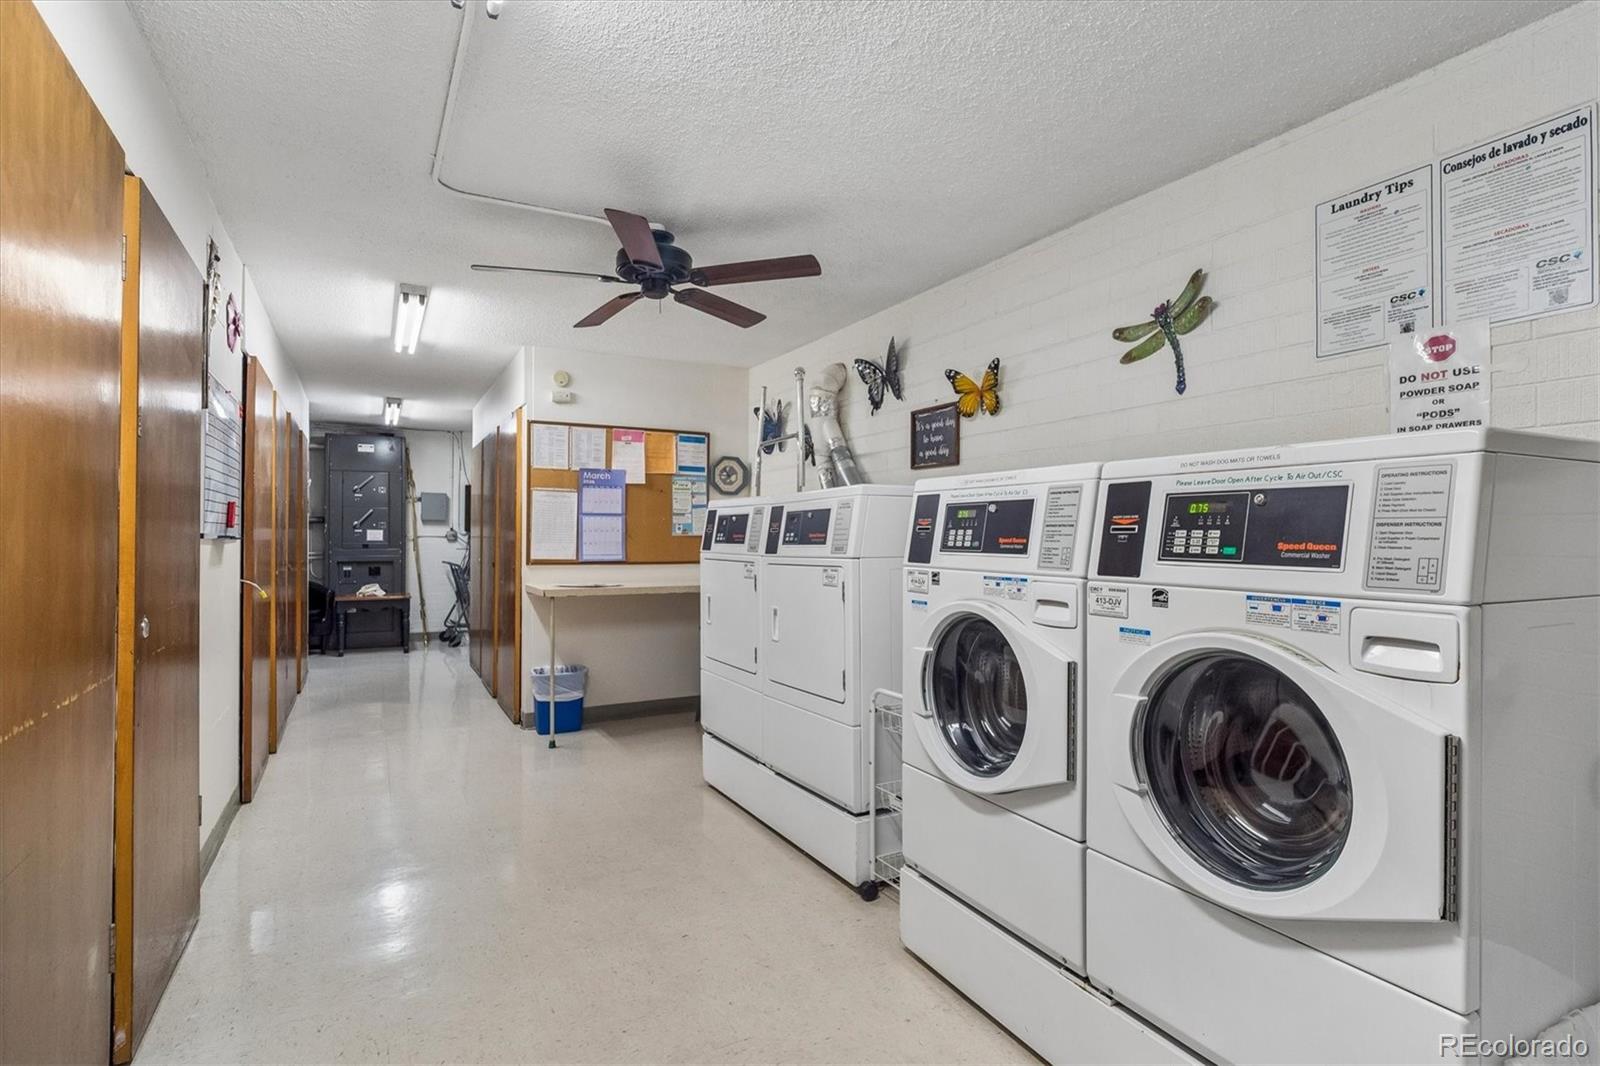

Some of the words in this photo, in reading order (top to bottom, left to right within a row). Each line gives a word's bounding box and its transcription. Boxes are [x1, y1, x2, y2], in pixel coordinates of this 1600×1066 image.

[1443, 154, 1487, 175] Consejos
[1489, 147, 1501, 160] de
[1503, 134, 1538, 154] lavado
[1540, 132, 1547, 144] y
[1550, 116, 1588, 138] secado
[1331, 190, 1382, 214] Laundry
[1385, 179, 1414, 195] Tips
[1494, 223, 1529, 236] SECADORAS
[1535, 254, 1571, 268] CSC
[1390, 291, 1417, 303] CSC
[1426, 344, 1453, 354] STOP
[1400, 375, 1416, 384] DO
[1421, 370, 1448, 381] NOT
[1452, 365, 1480, 377] USE
[1400, 386, 1445, 399] POWDER
[1448, 382, 1480, 393] SOAP
[1409, 424, 1433, 432] SOAP
[1436, 419, 1482, 430] DRAWERS
[583, 471, 612, 480] March
[1227, 476, 1243, 484] Open
[1245, 475, 1263, 483] After
[1264, 474, 1283, 482] Cycle
[1189, 504, 1209, 513] 0.75
[1277, 542, 1305, 551] Speed
[1307, 542, 1337, 551] Queen
